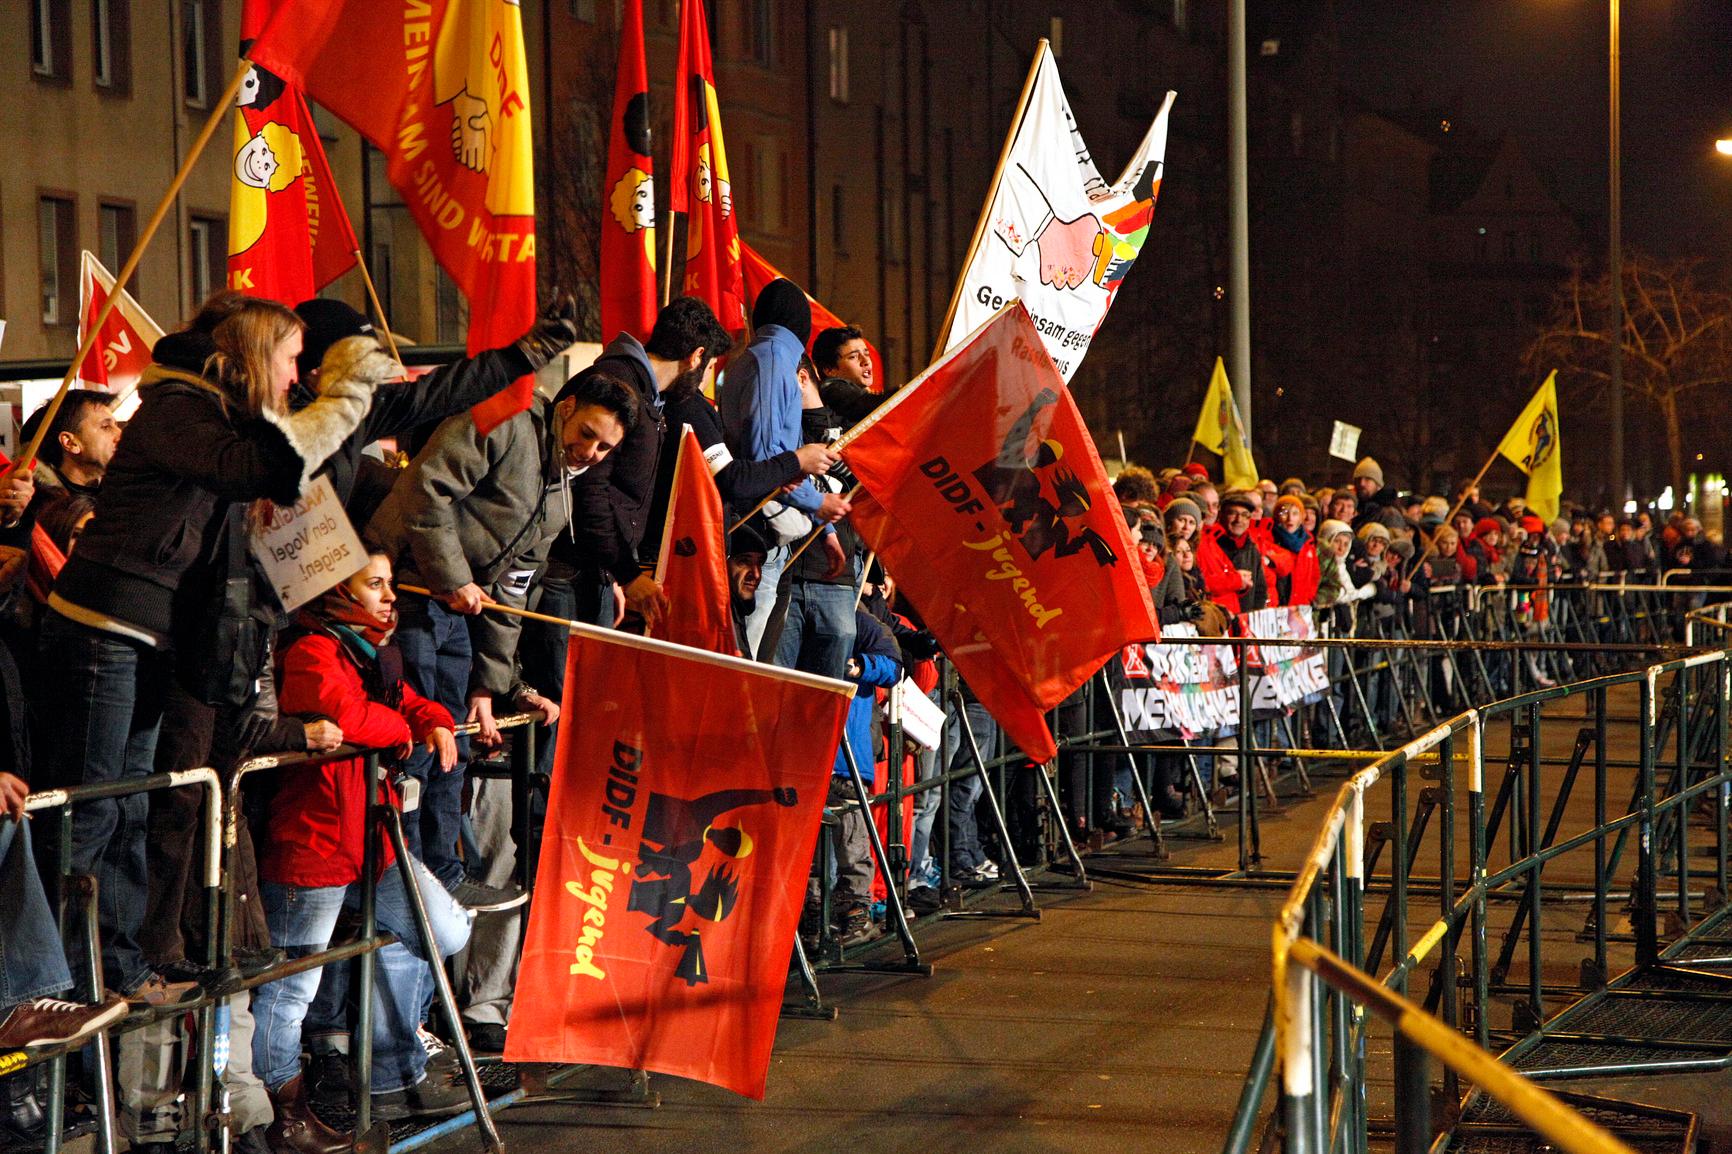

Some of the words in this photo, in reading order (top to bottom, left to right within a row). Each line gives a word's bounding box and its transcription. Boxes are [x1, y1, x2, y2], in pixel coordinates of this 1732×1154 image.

[413, 160, 465, 230] SIND
[962, 529, 1063, 630] jugend
[565, 835, 632, 981] jugend
